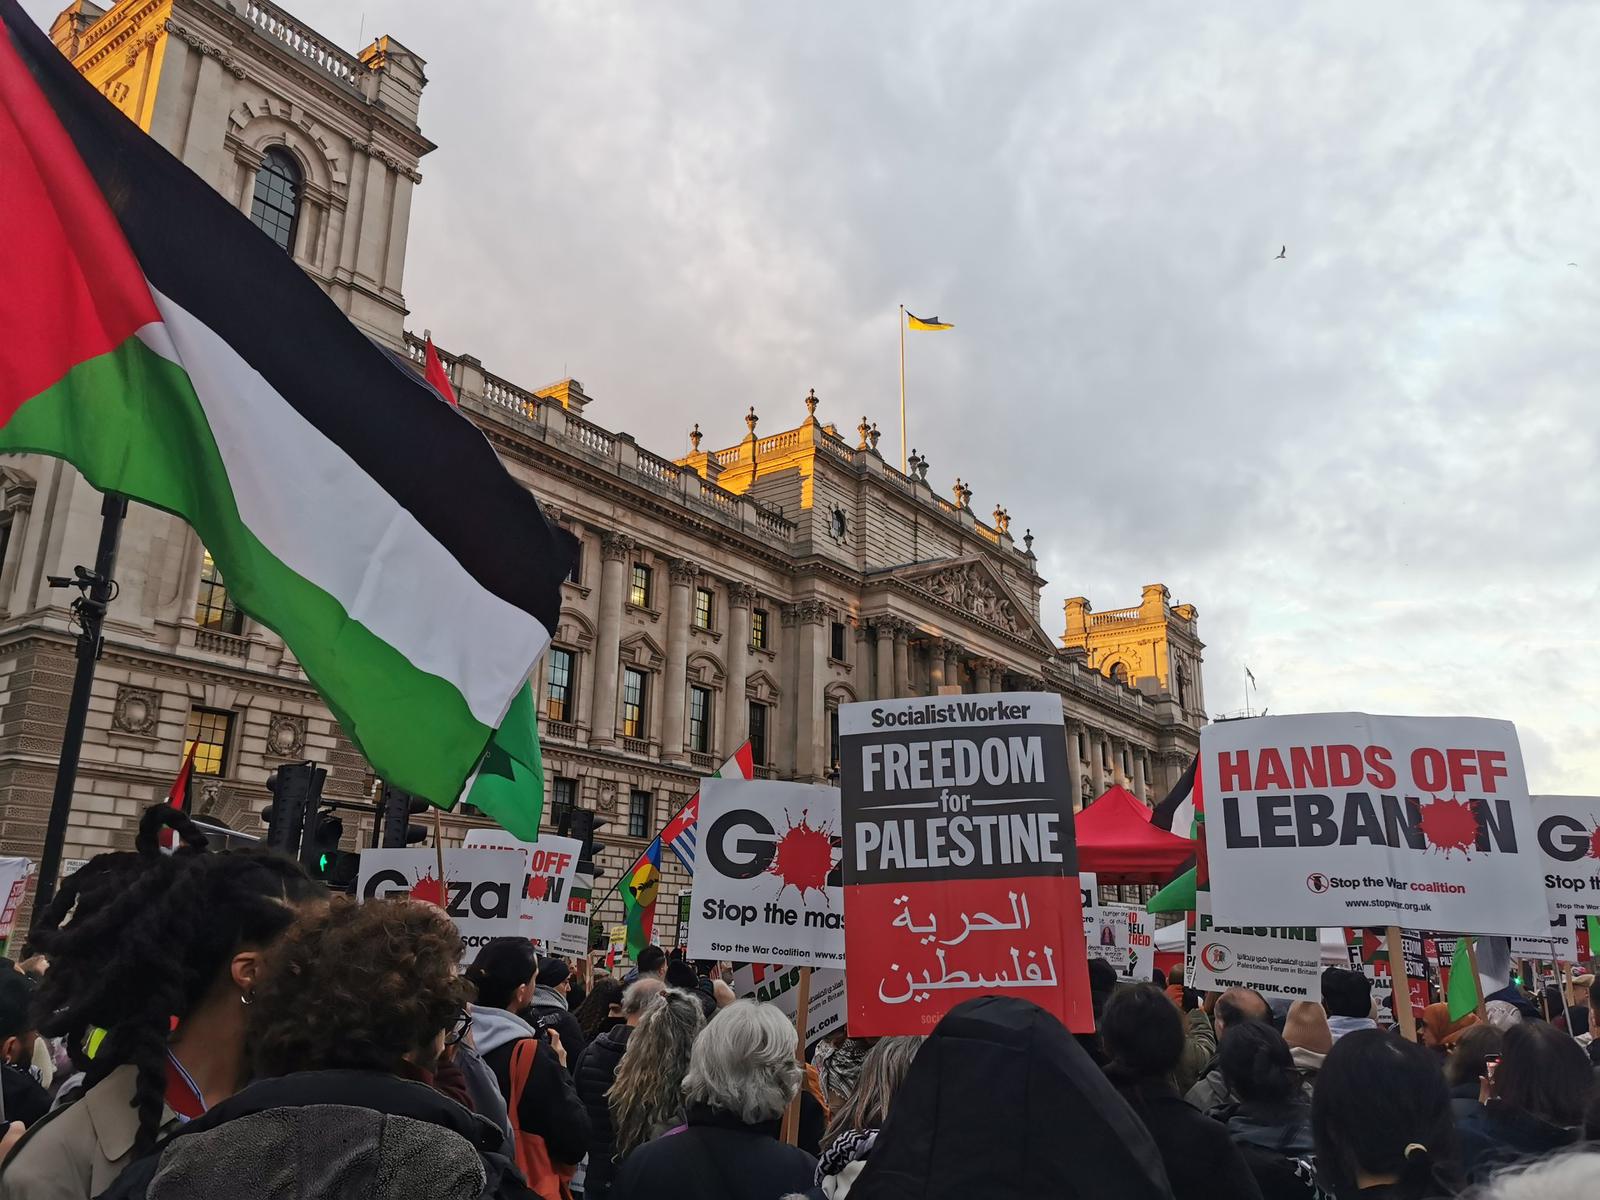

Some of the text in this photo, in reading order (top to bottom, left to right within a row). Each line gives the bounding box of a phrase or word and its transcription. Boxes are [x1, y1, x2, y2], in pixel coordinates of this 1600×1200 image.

[862, 736, 1045, 792] FREEDOM
[1218, 744, 1508, 793] HANDS OFF
[940, 789, 971, 813] for
[1223, 792, 1519, 854] LEBANN
[855, 813, 1063, 871] PALESTINE
[531, 850, 571, 873] OFF
[1330, 876, 1466, 895] Stop the War coalition
[1545, 874, 1586, 892] Stop
[703, 898, 757, 926] Stop
[764, 902, 798, 925] the
[892, 890, 1031, 946] الحرية
[1556, 902, 1572, 910] Stop
[711, 942, 732, 952] Stop
[735, 943, 749, 953] the
[752, 944, 770, 955] War
[771, 946, 811, 958] Coalition
[878, 946, 1058, 1004] لفلسطين
[1237, 961, 1269, 972] Palestinian
[1298, 967, 1318, 976] Britain
